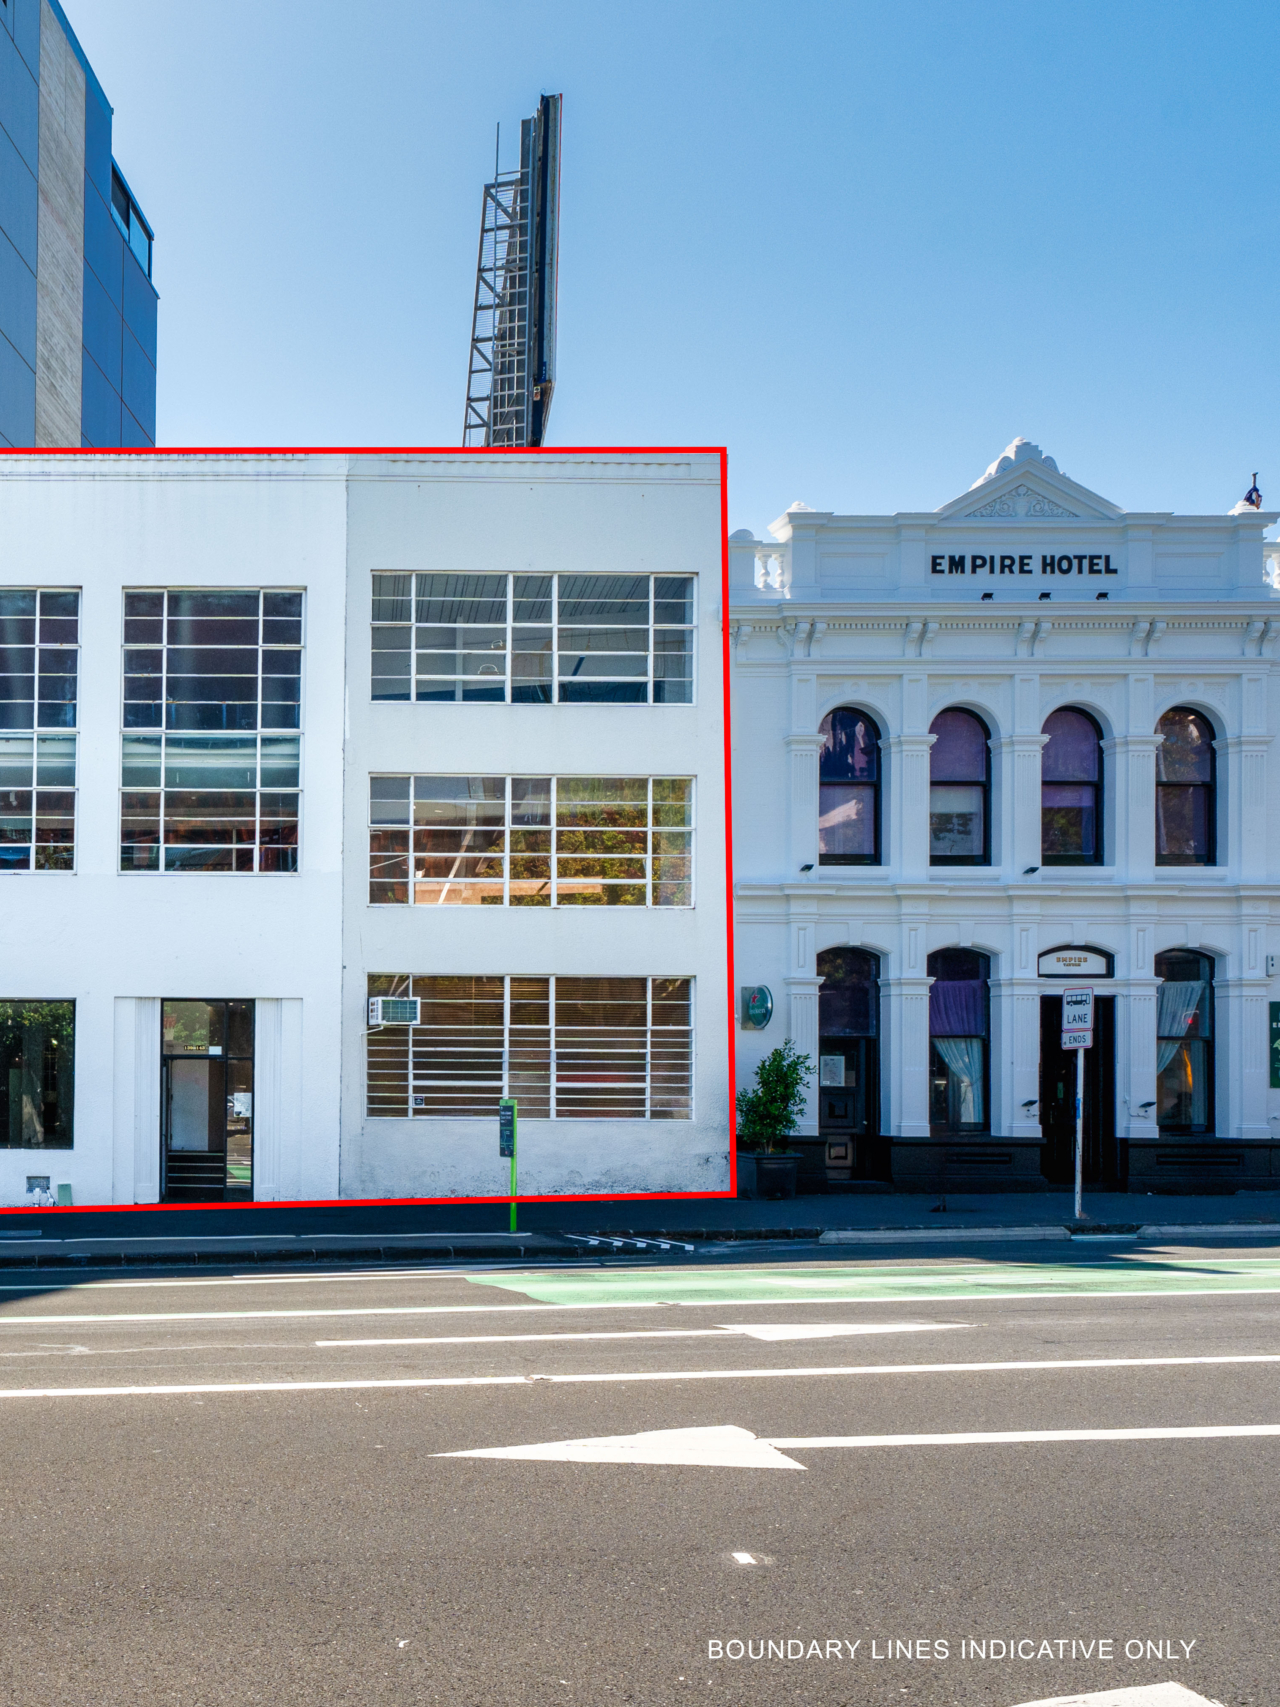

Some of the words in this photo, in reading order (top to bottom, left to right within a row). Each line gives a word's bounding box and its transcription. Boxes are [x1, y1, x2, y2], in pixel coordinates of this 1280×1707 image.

[931, 555, 1033, 575] EMPIRE
[1041, 555, 1118, 575] HOTEL
[1067, 1013, 1088, 1024] LANE
[1069, 1035, 1087, 1044] ENDS
